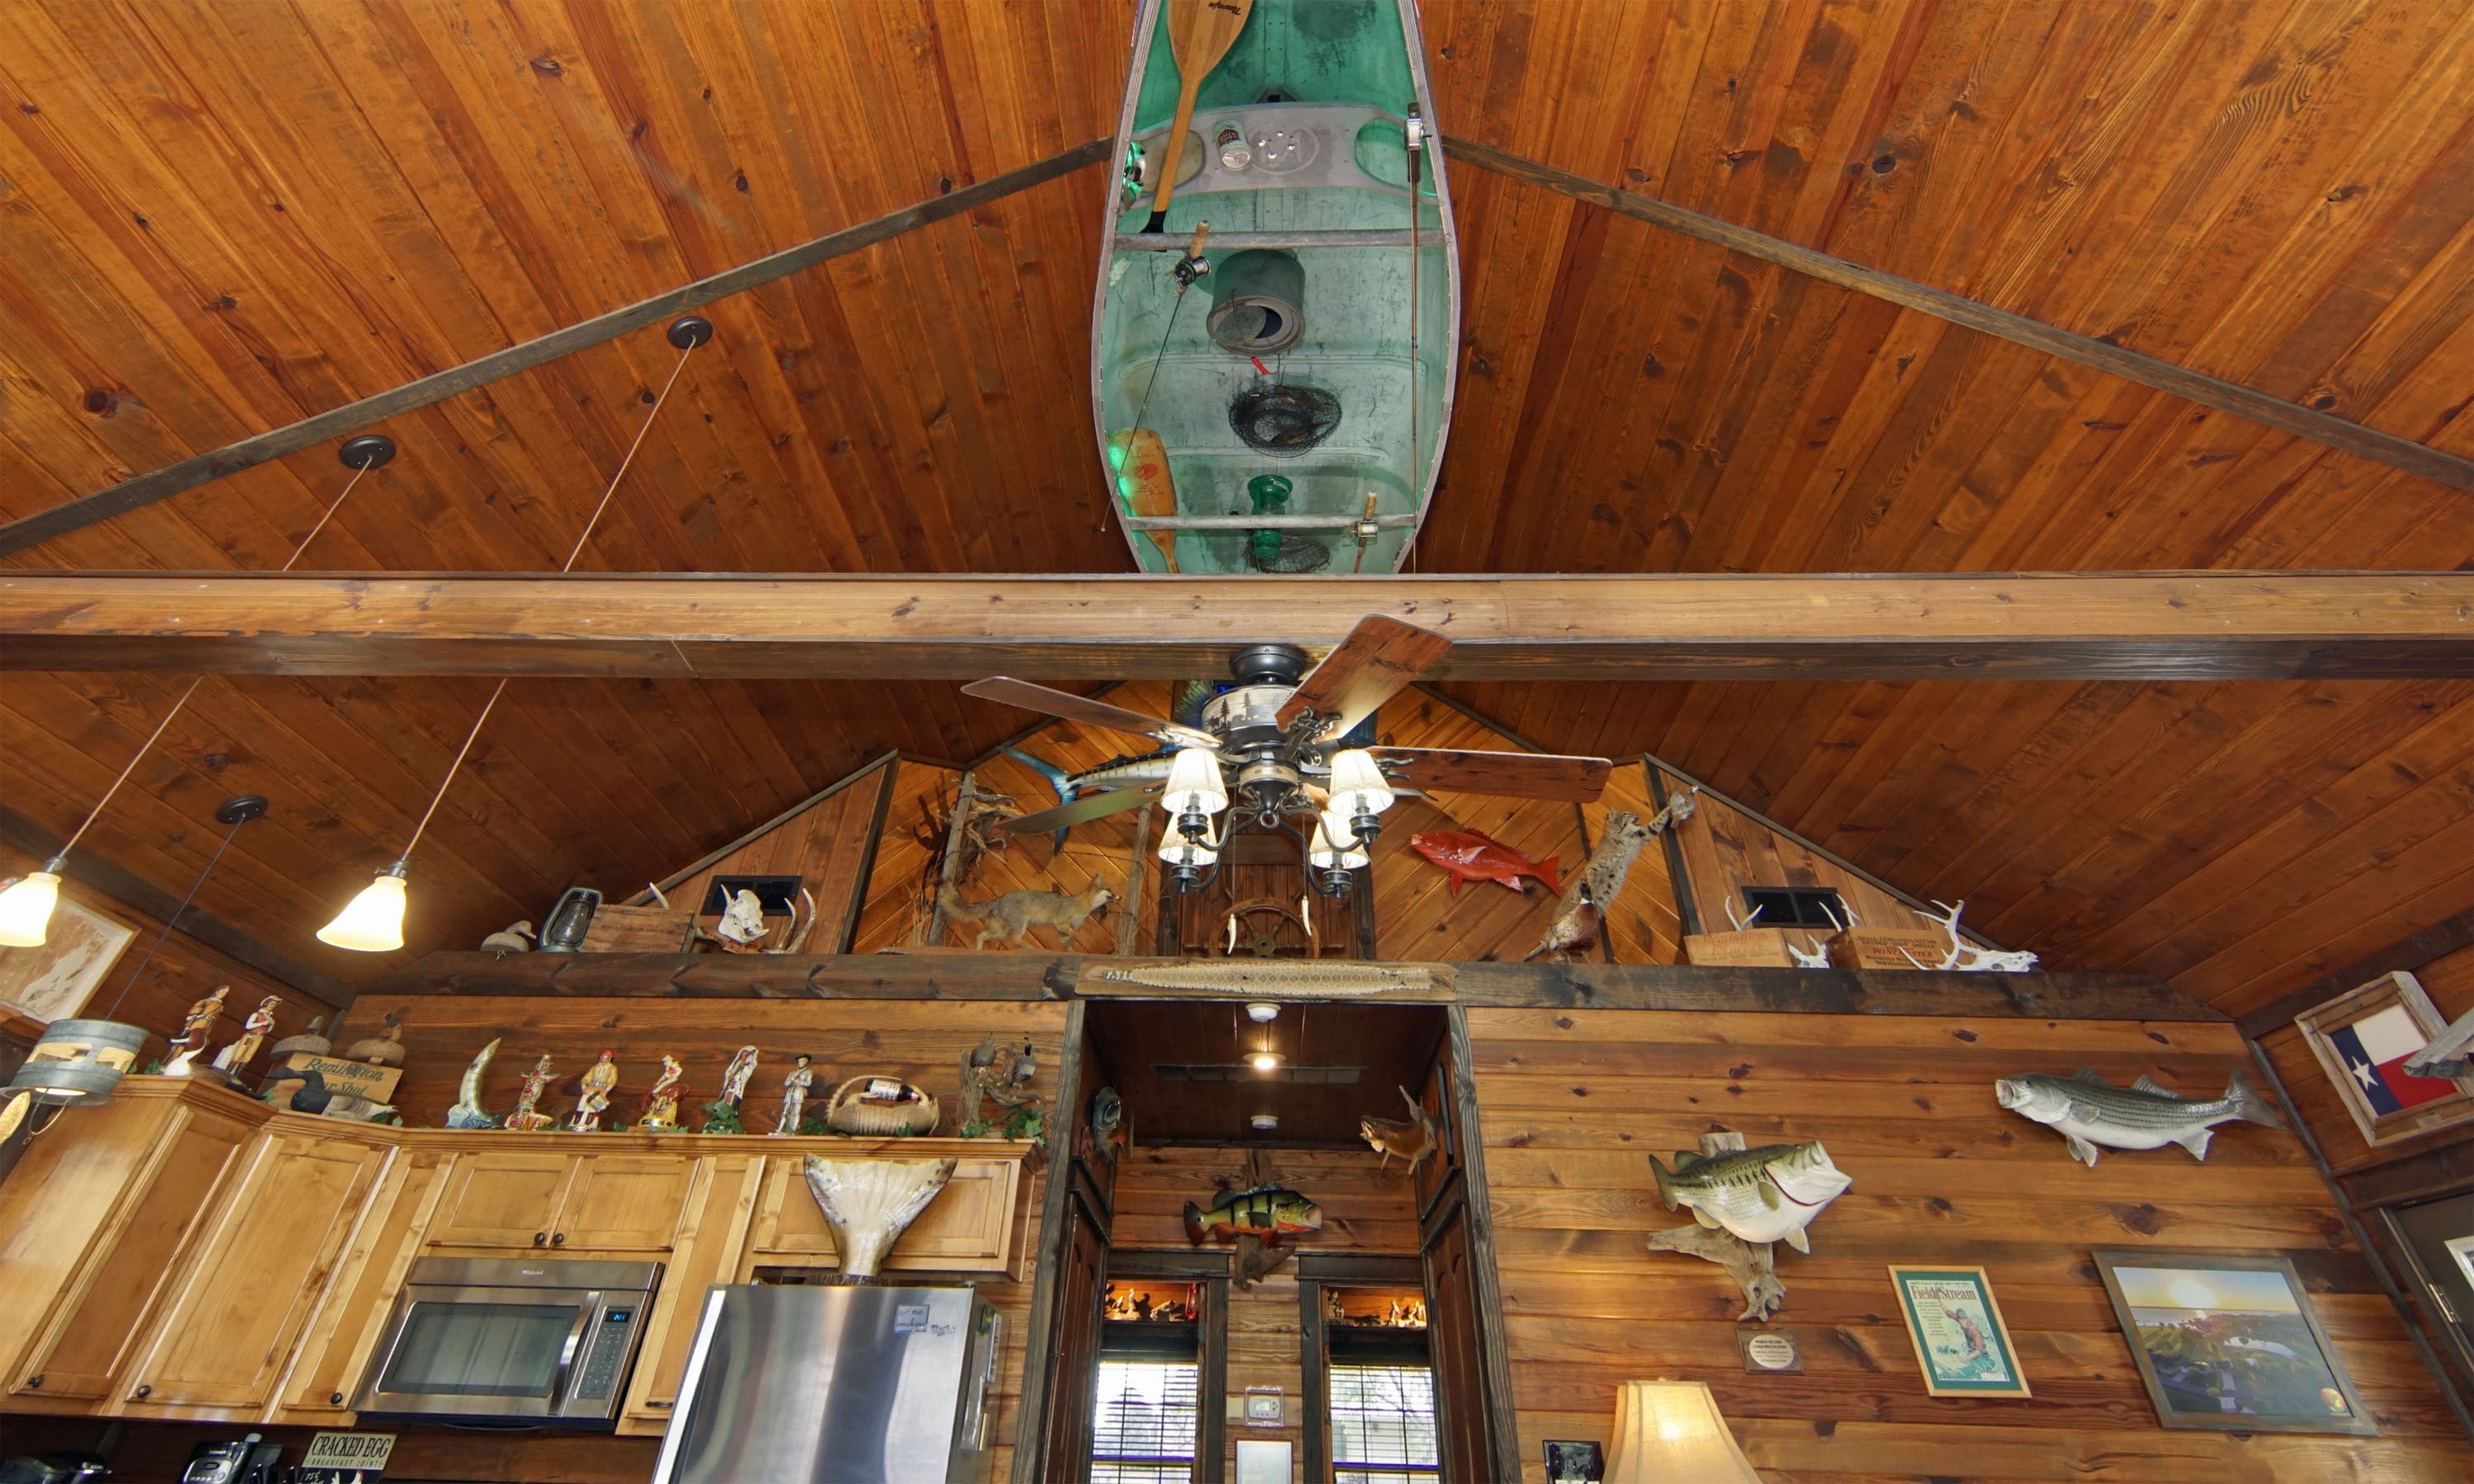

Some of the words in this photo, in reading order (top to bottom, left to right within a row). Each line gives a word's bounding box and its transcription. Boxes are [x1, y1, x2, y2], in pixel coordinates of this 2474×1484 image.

[303, 1058, 384, 1082] Remigton
[1911, 1285, 1935, 1299] Field
[1940, 1285, 1977, 1300] Stream
[312, 1435, 365, 1457] CRACKED
[363, 1437, 391, 1458] EGG
[312, 1458, 354, 1467] BREAKFAST
